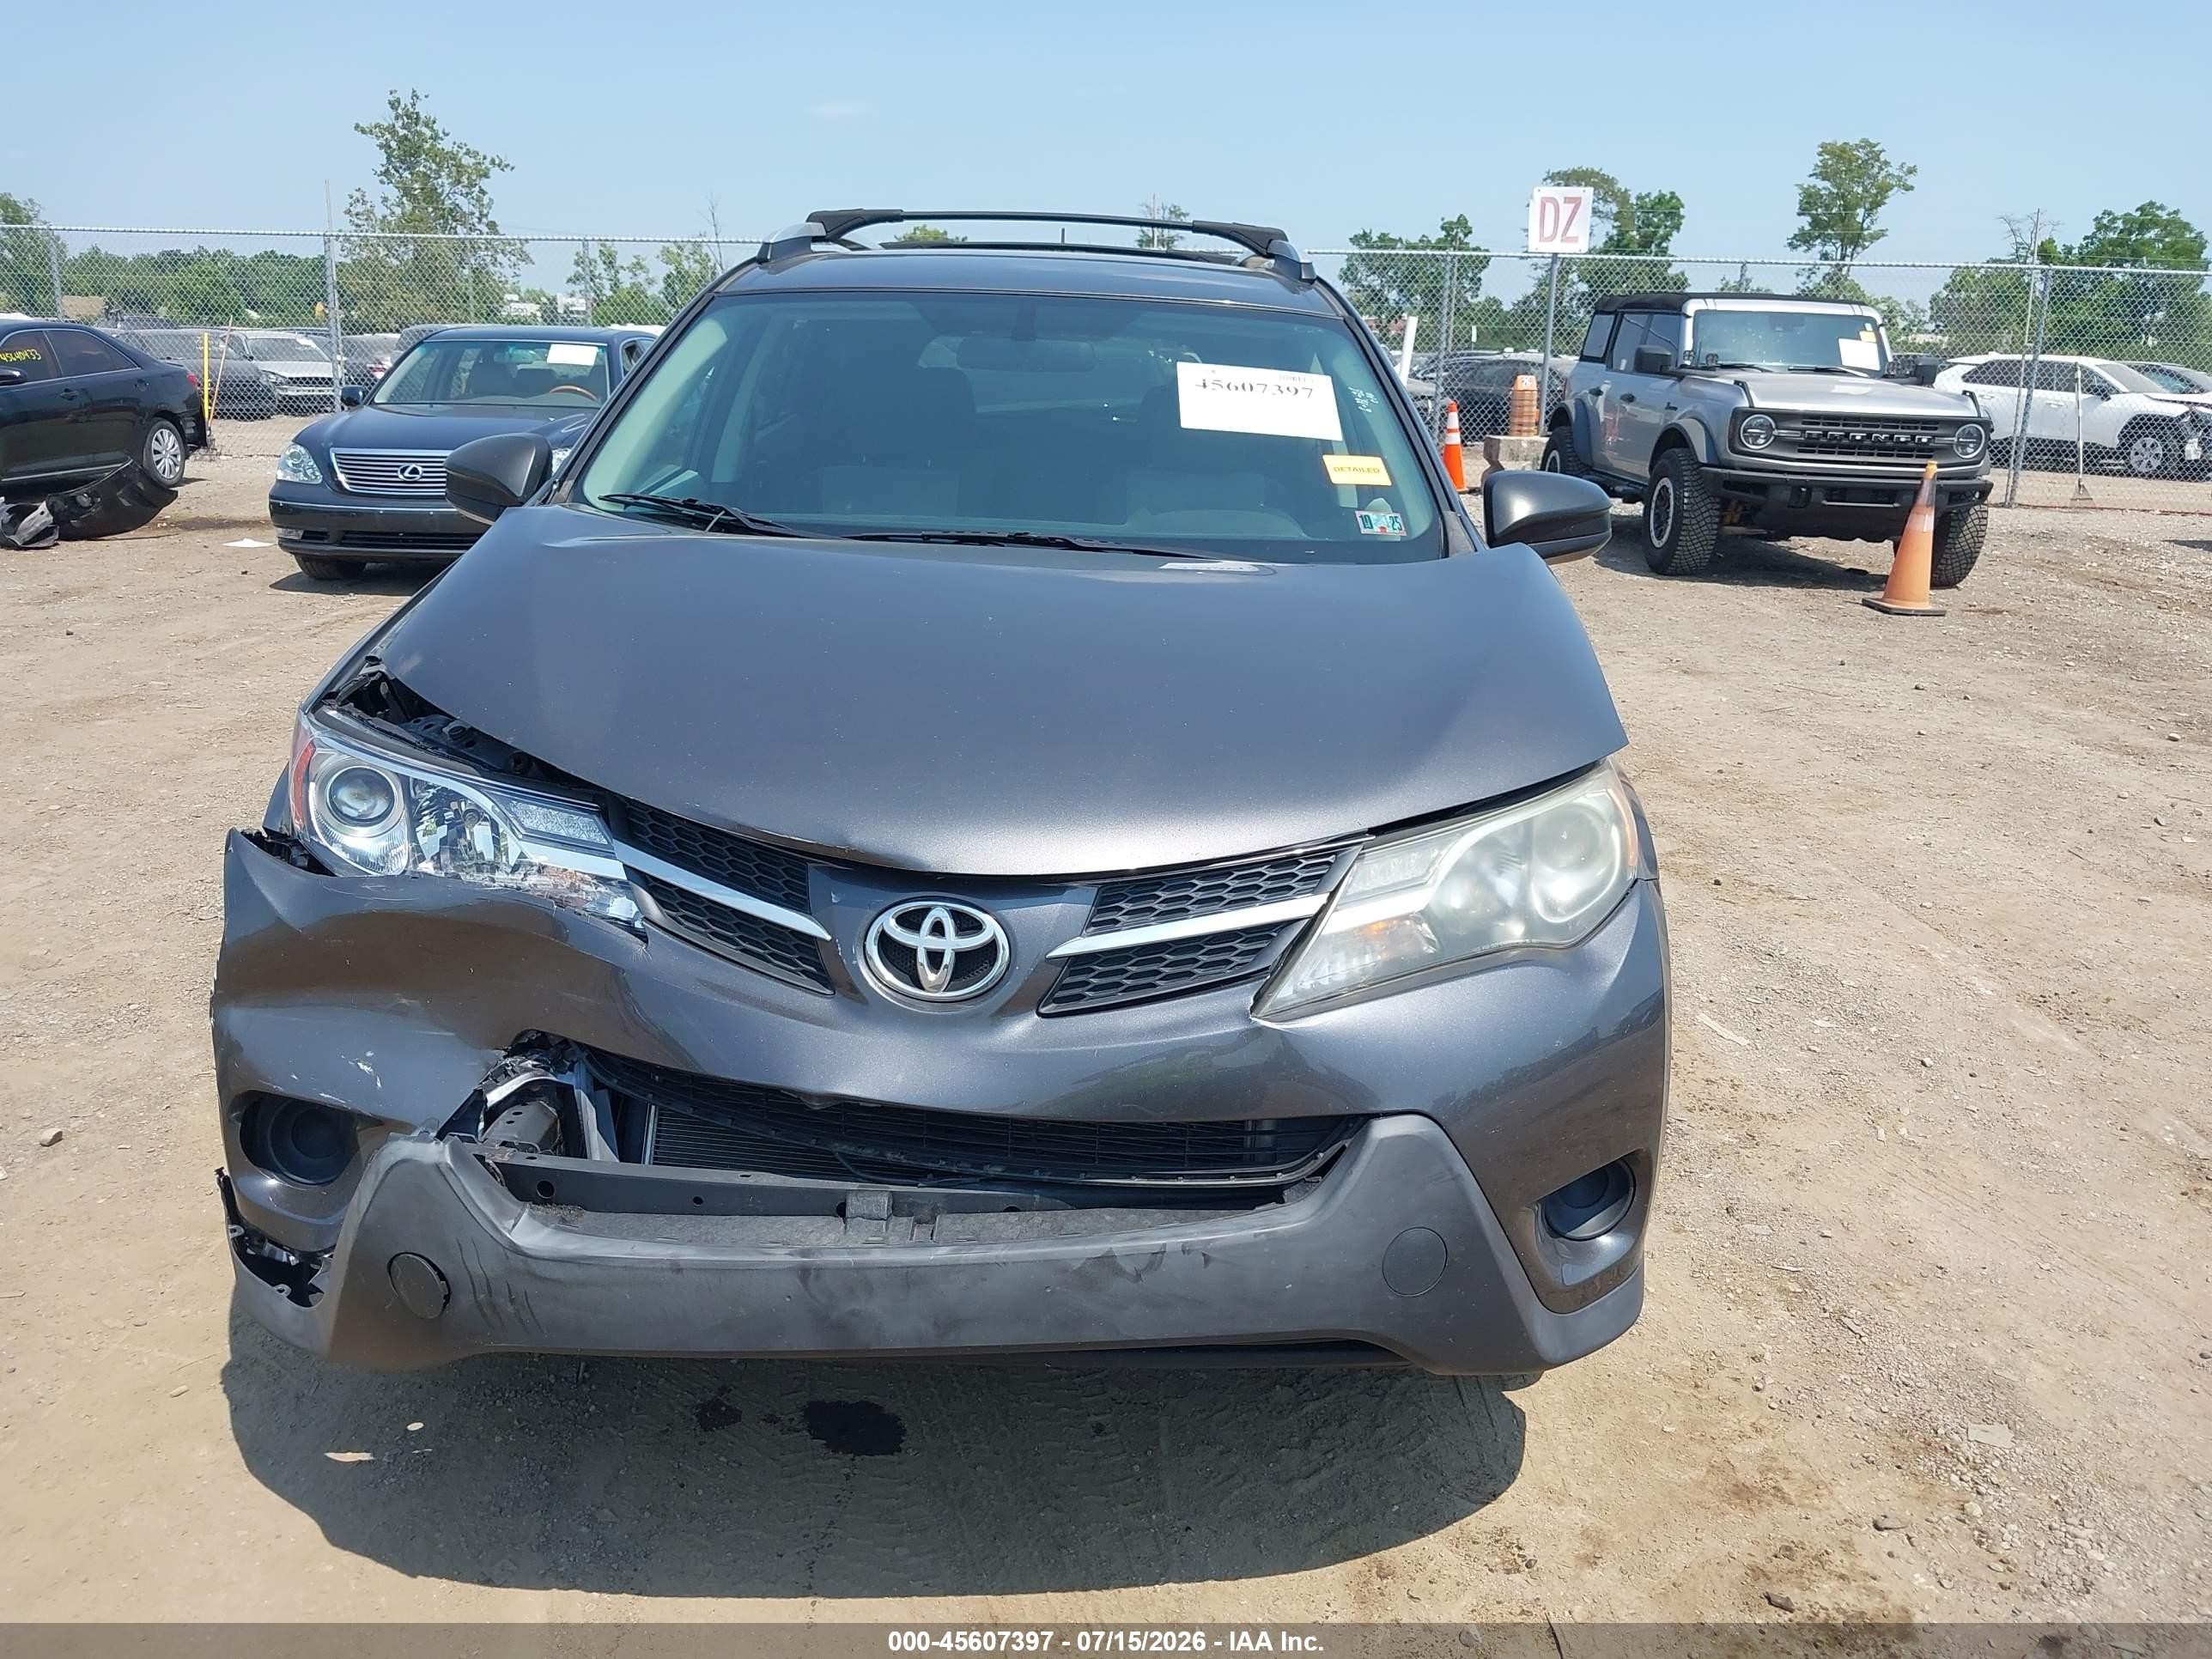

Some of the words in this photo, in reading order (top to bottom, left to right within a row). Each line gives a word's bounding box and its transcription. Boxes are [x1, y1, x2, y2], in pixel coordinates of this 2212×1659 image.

[1539, 197, 1582, 243] DZ
[1194, 378, 1314, 399] 45607397
[1389, 515, 1402, 531] 25
